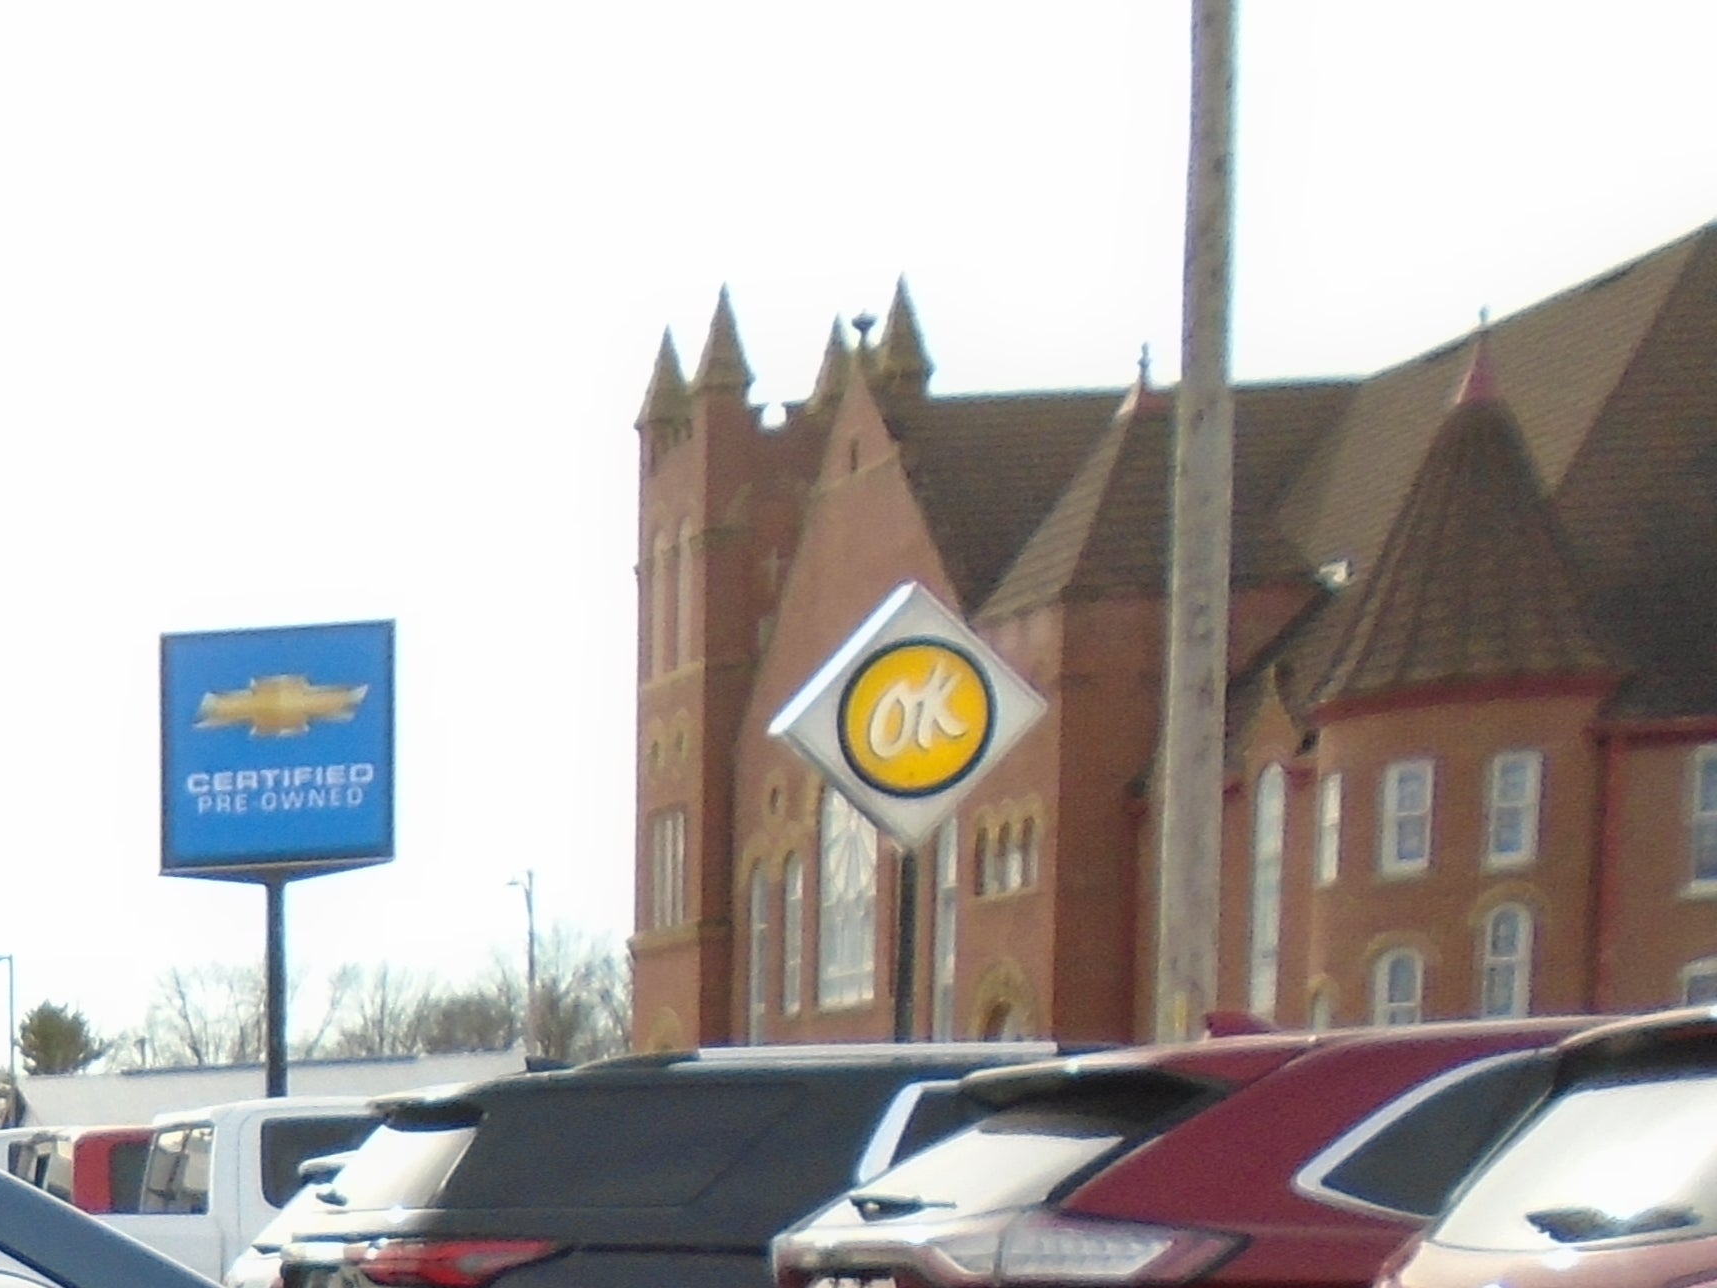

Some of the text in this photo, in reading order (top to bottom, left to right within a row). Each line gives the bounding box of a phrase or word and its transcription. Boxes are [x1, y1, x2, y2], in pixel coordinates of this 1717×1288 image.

[869, 660, 969, 759] OK
[187, 763, 373, 793] CERTIFIED
[199, 787, 363, 814] PRE OWNED
